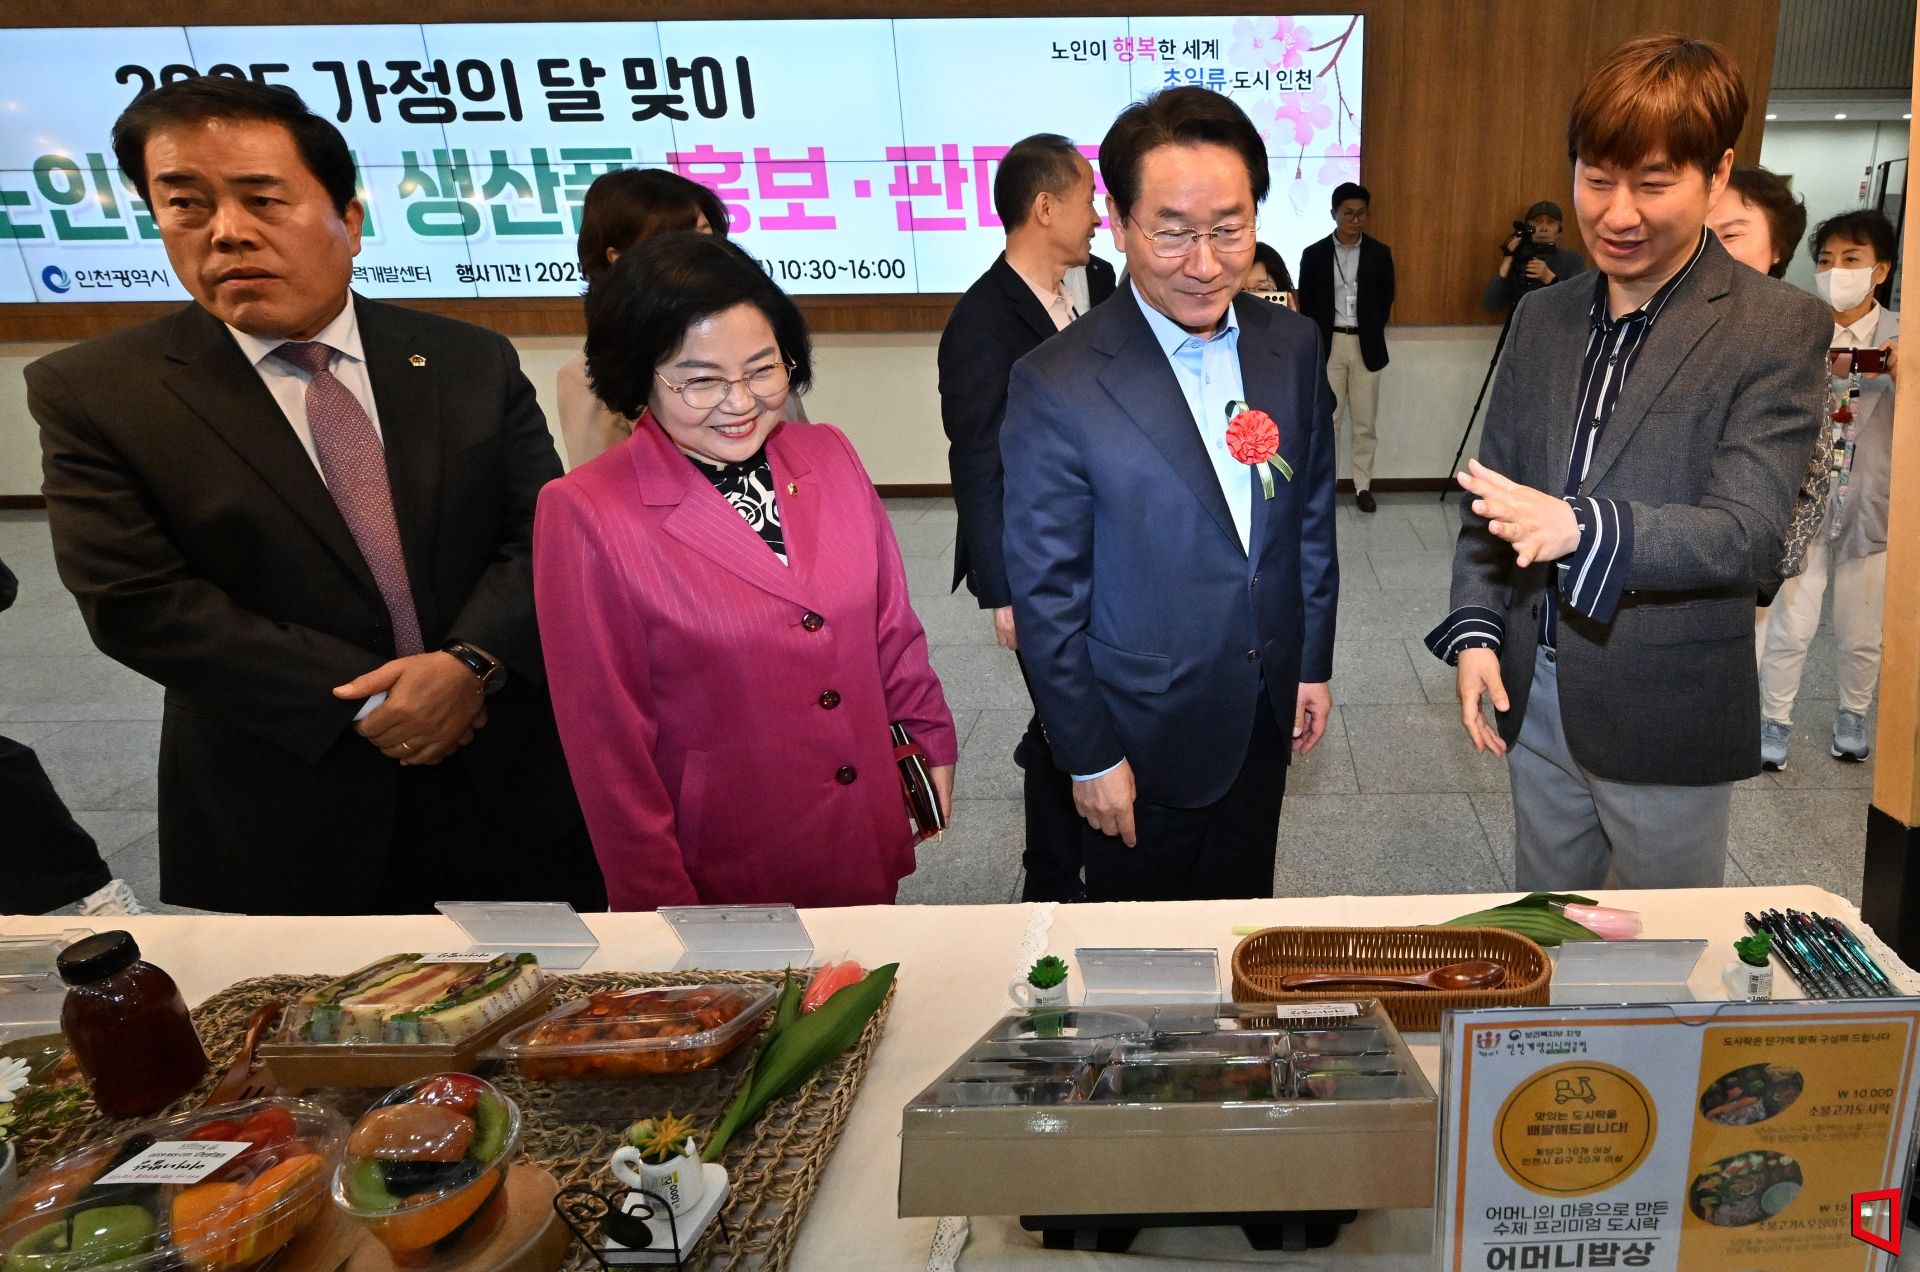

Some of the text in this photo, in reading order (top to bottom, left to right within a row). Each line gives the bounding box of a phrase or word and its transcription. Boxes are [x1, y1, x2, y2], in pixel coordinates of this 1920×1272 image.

[1051, 36, 1220, 63] 노인이 행복한 세계
[312, 57, 524, 124] 가정의
[537, 57, 607, 123] 달
[622, 55, 756, 123] 맞이
[1233, 69, 1270, 91] 도시
[1275, 69, 1313, 91] 인천
[75, 269, 171, 288] 인천광역시
[455, 263, 522, 284] 행사기간
[778, 259, 906, 281] 10:30~16:00
[1485, 1201, 1670, 1221] 어머니의 마음으로 만든
[1493, 1216, 1661, 1236] 수제 프리미엄 도시락
[1486, 1241, 1656, 1271] 어머니밥상
